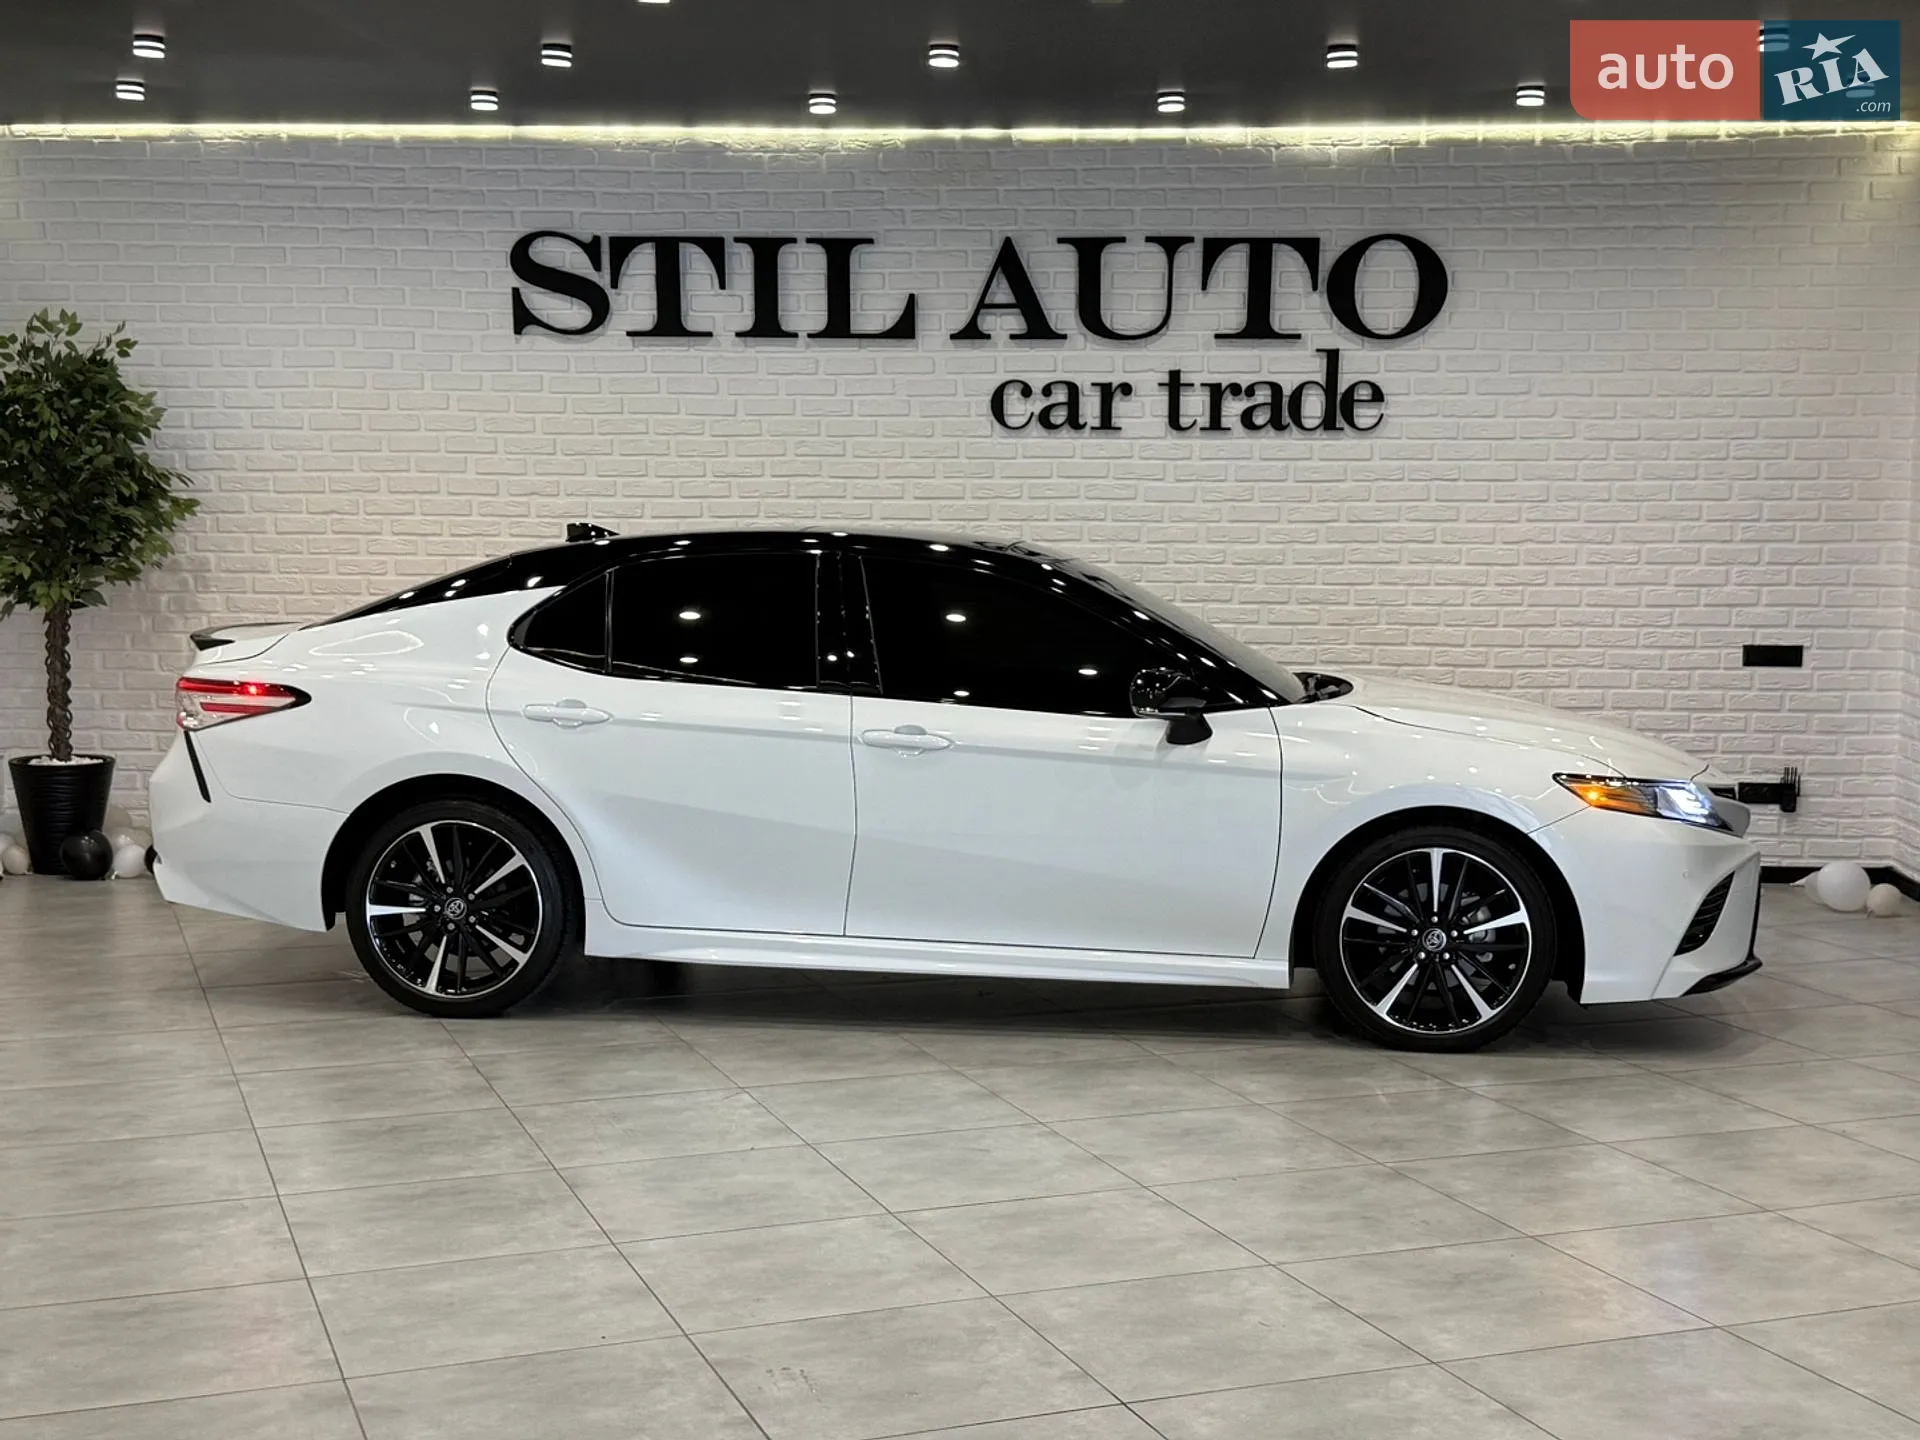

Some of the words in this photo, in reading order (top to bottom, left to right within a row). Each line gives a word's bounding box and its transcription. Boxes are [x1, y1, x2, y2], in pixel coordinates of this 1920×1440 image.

[510, 230, 916, 339] STIL
[949, 232, 1449, 341] AUTO
[990, 379, 1133, 431] car
[1157, 347, 1385, 432] trade
